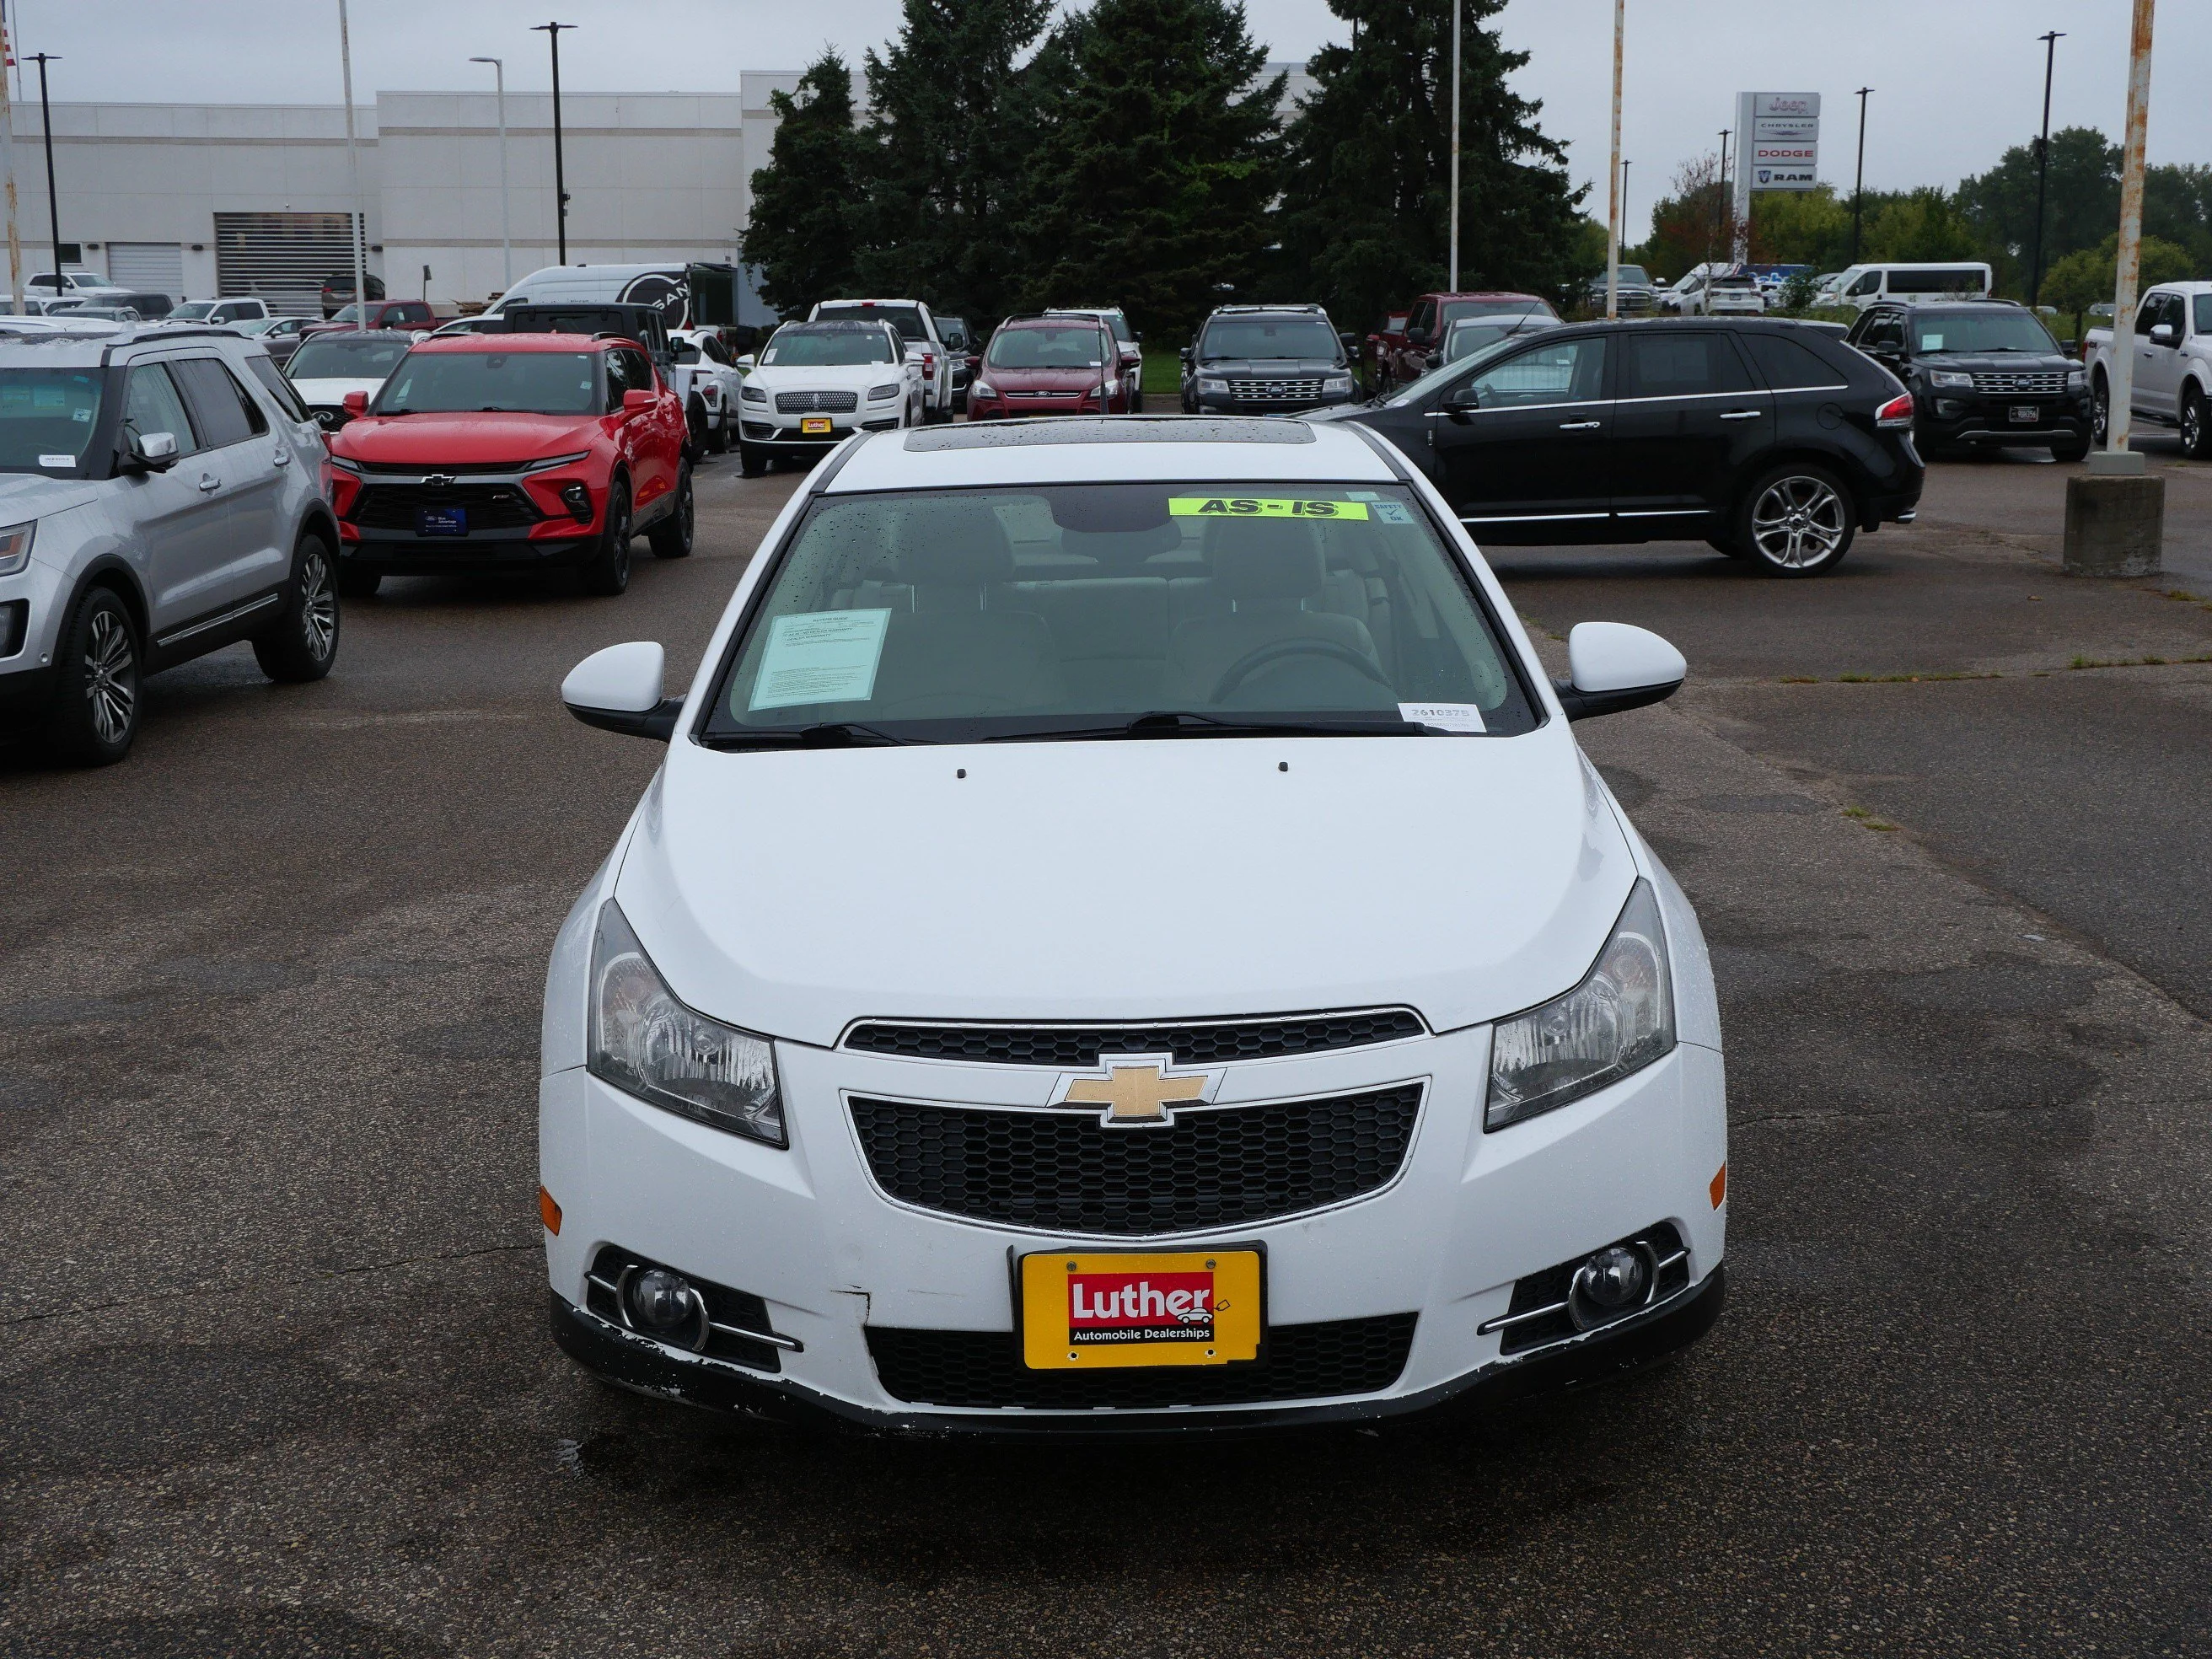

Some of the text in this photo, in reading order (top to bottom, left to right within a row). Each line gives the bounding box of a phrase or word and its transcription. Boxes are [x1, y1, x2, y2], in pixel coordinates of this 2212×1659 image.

[1769, 97, 1807, 114] Jeep
[652, 283, 689, 310] SAN
[1073, 1281, 1211, 1318] Luther
[1073, 1328, 1211, 1341] Automobile Dealerships
